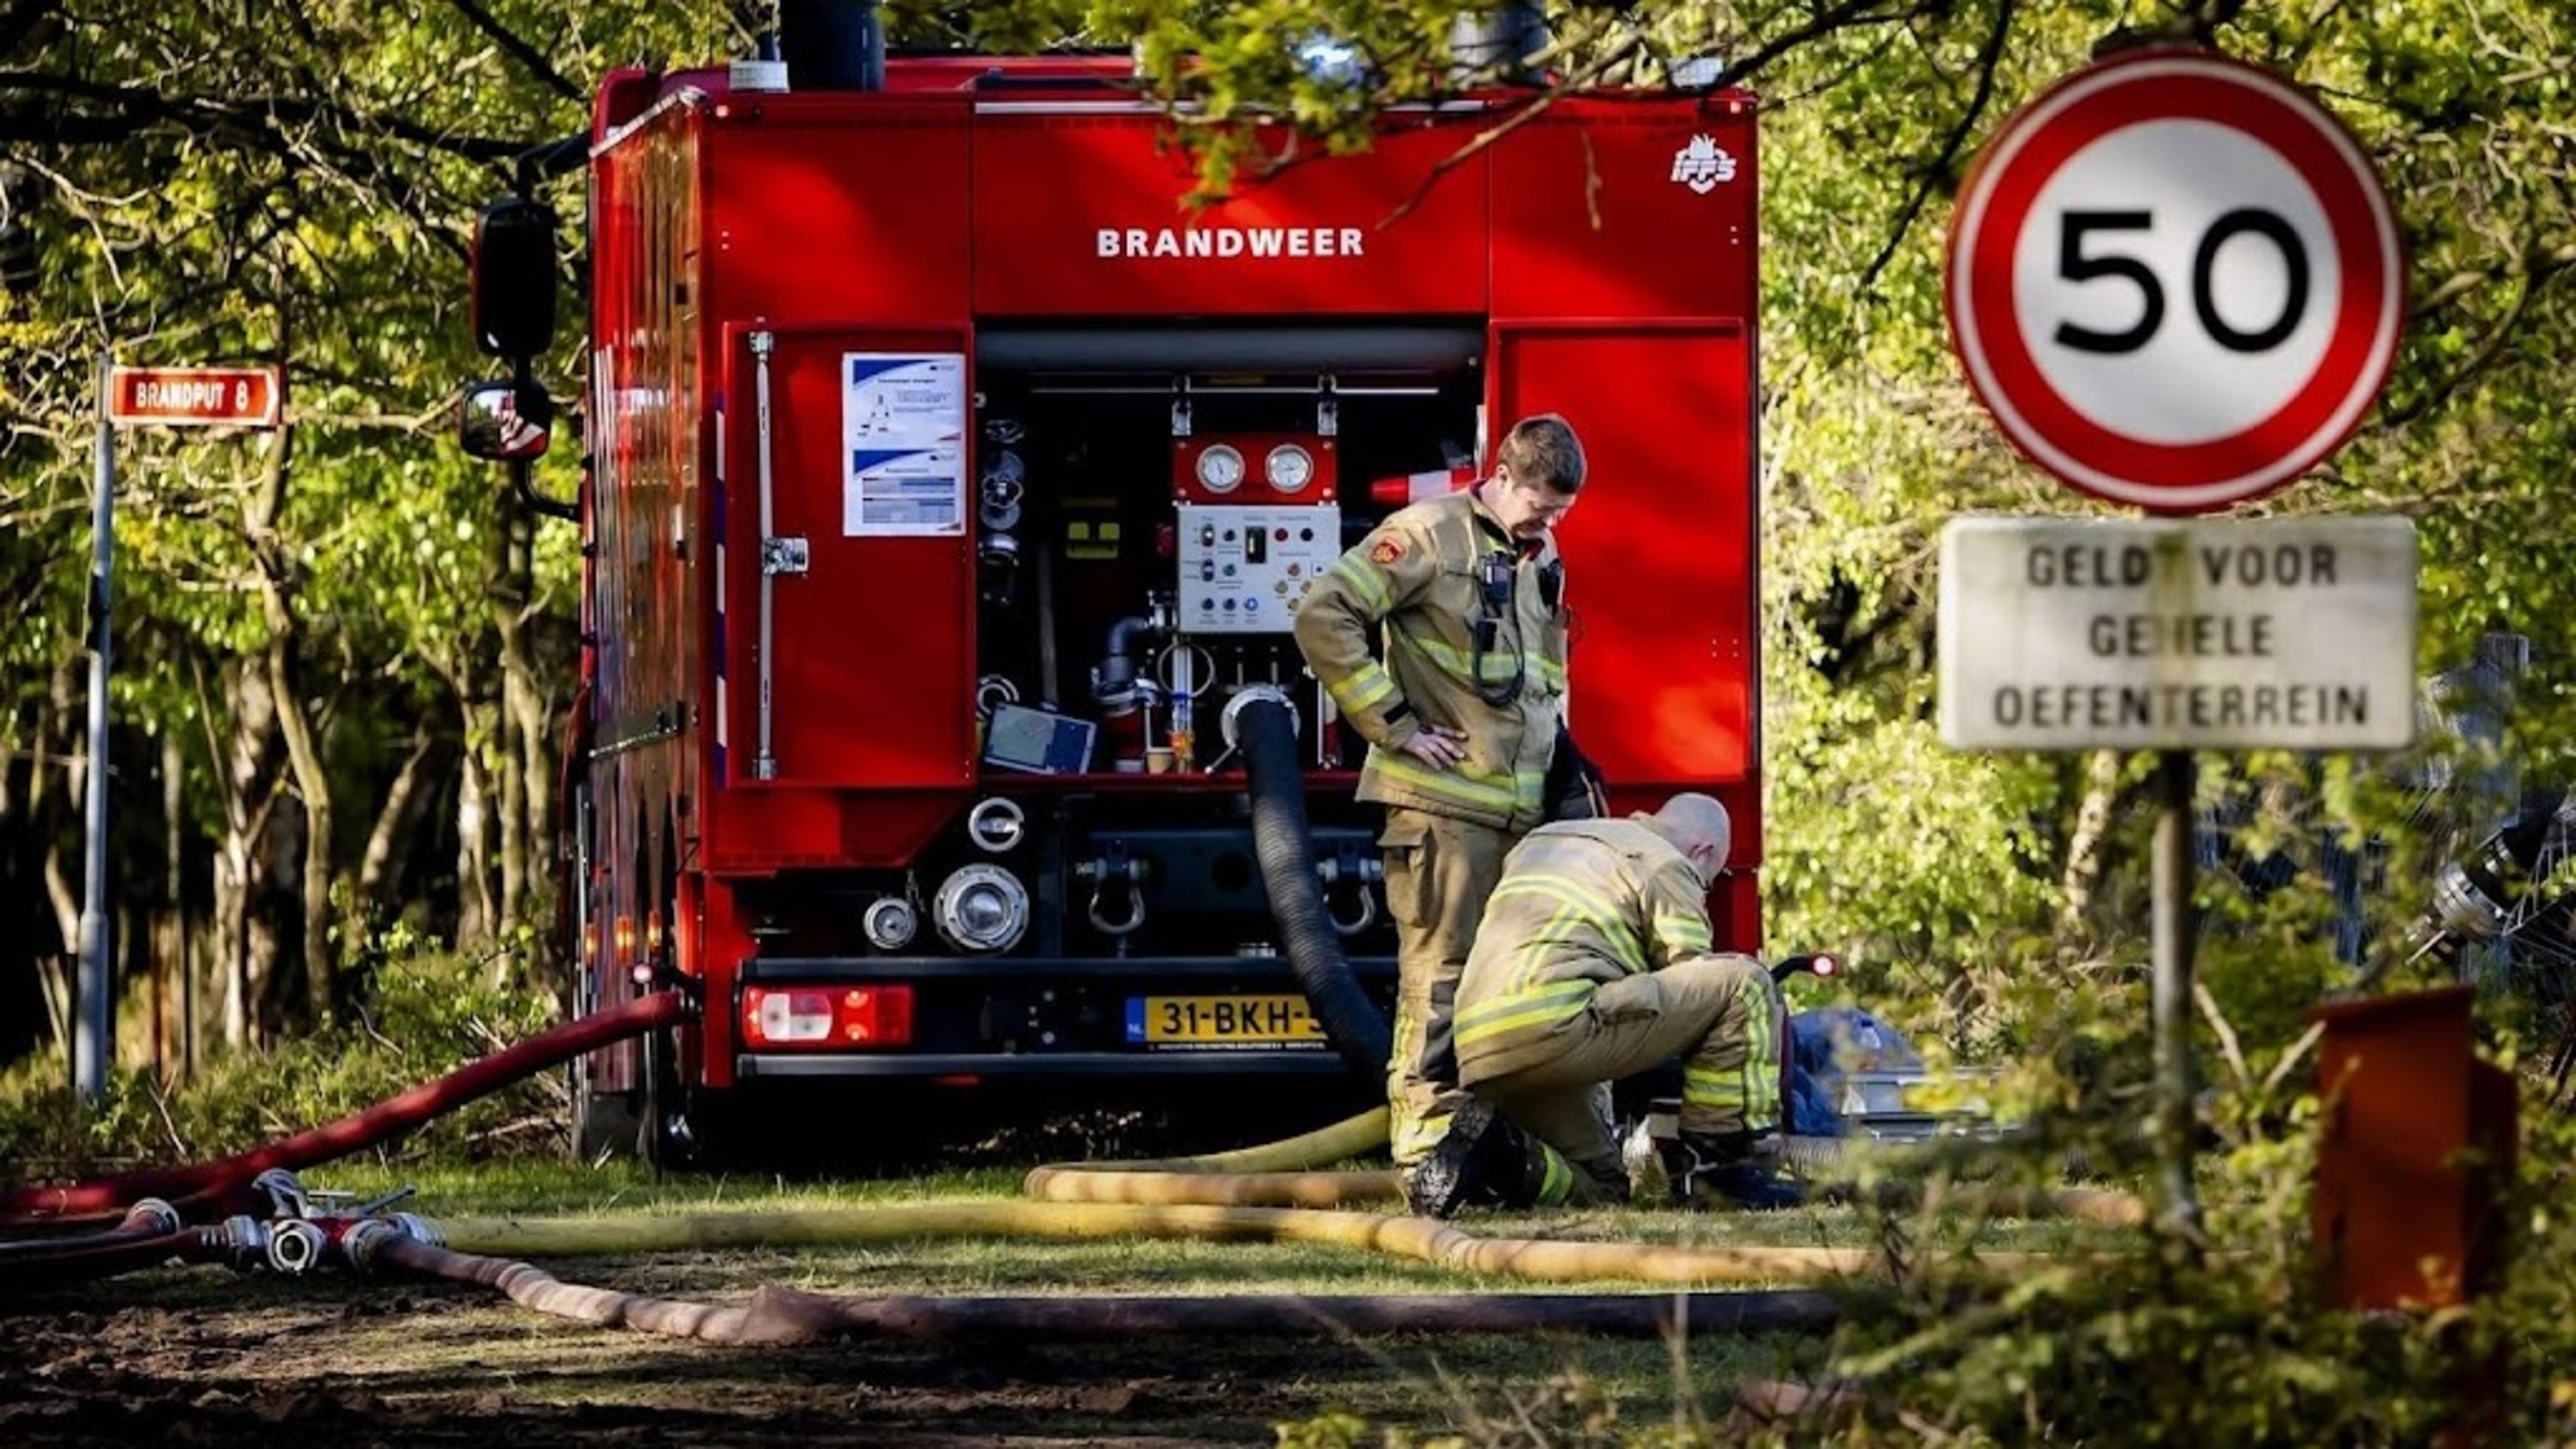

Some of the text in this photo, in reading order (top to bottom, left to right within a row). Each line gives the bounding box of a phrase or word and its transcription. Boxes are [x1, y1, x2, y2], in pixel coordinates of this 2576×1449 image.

[1097, 229, 1364, 257] BRANDWEER
[2053, 206, 2310, 354] 50
[135, 380, 249, 411] BRANDPUT 8
[2200, 543, 2338, 586] VOOR
[1994, 684, 2369, 727] OEFENTERREIN
[1127, 1023, 1143, 1035] NL
